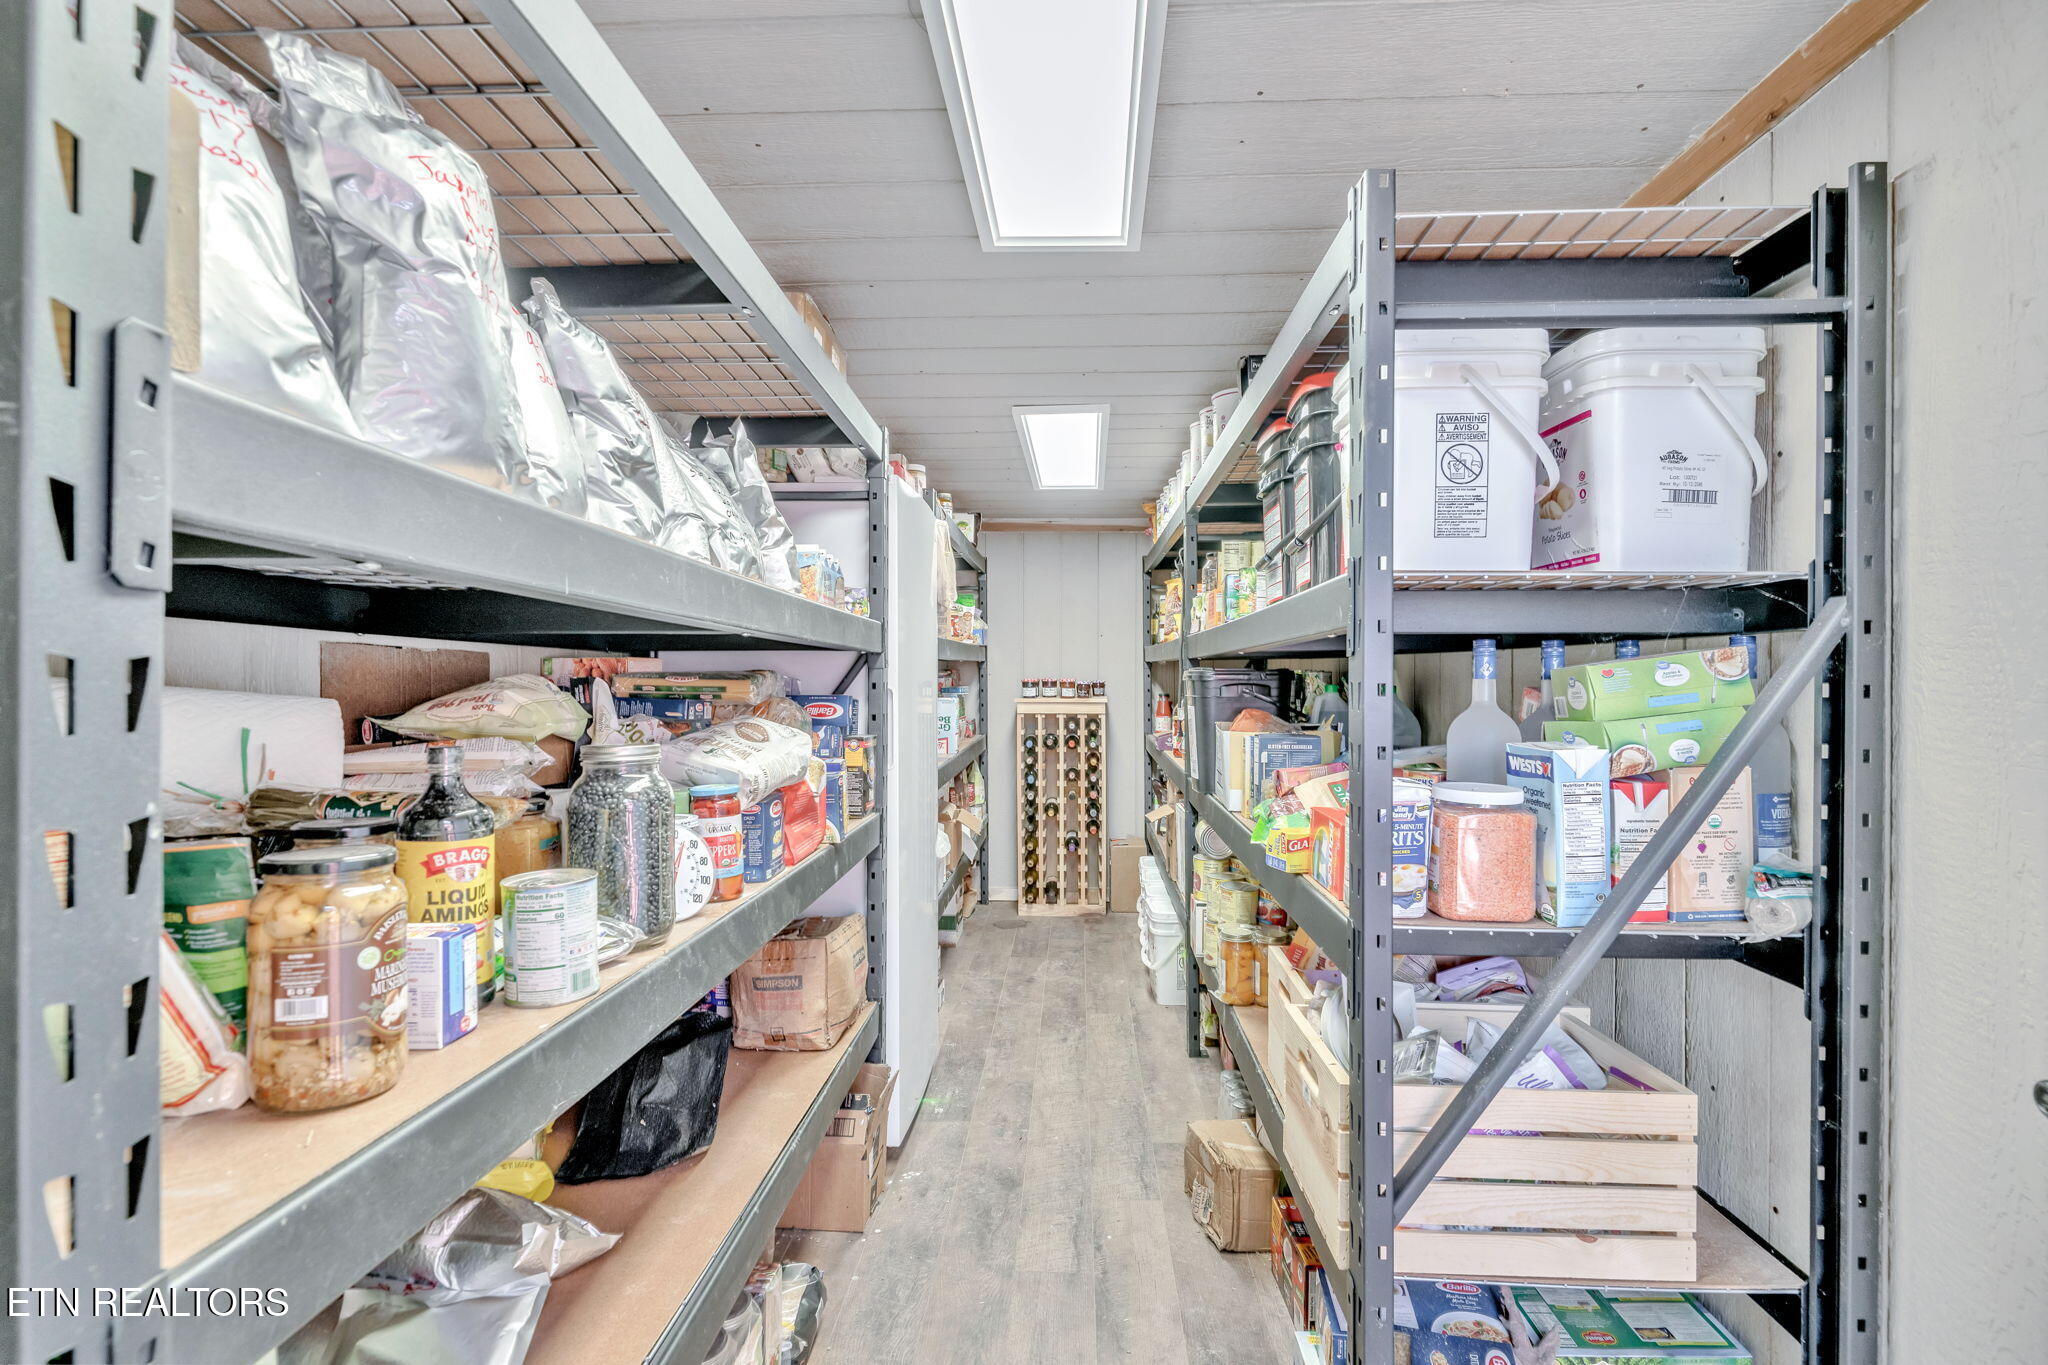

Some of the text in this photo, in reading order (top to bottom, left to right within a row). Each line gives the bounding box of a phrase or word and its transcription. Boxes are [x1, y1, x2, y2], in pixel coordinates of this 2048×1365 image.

[1453, 423, 1479, 431] AVISO
[806, 703, 835, 717] Barilla
[1522, 785, 1545, 798] Organic
[708, 824, 732, 834] ORGANIC
[1392, 830, 1425, 846] RITS
[689, 840, 699, 849] 60
[1288, 839, 1310, 852] GLA
[432, 847, 489, 867] BRAGG
[699, 857, 709, 865] 80
[700, 875, 711, 885] 100
[427, 884, 486, 906] LIQUID
[545, 892, 564, 900] Facts
[692, 893, 703, 903] 120
[420, 899, 489, 923] AMINOS
[755, 978, 799, 988] SIMPSON
[1446, 1283, 1477, 1292] Barilla
